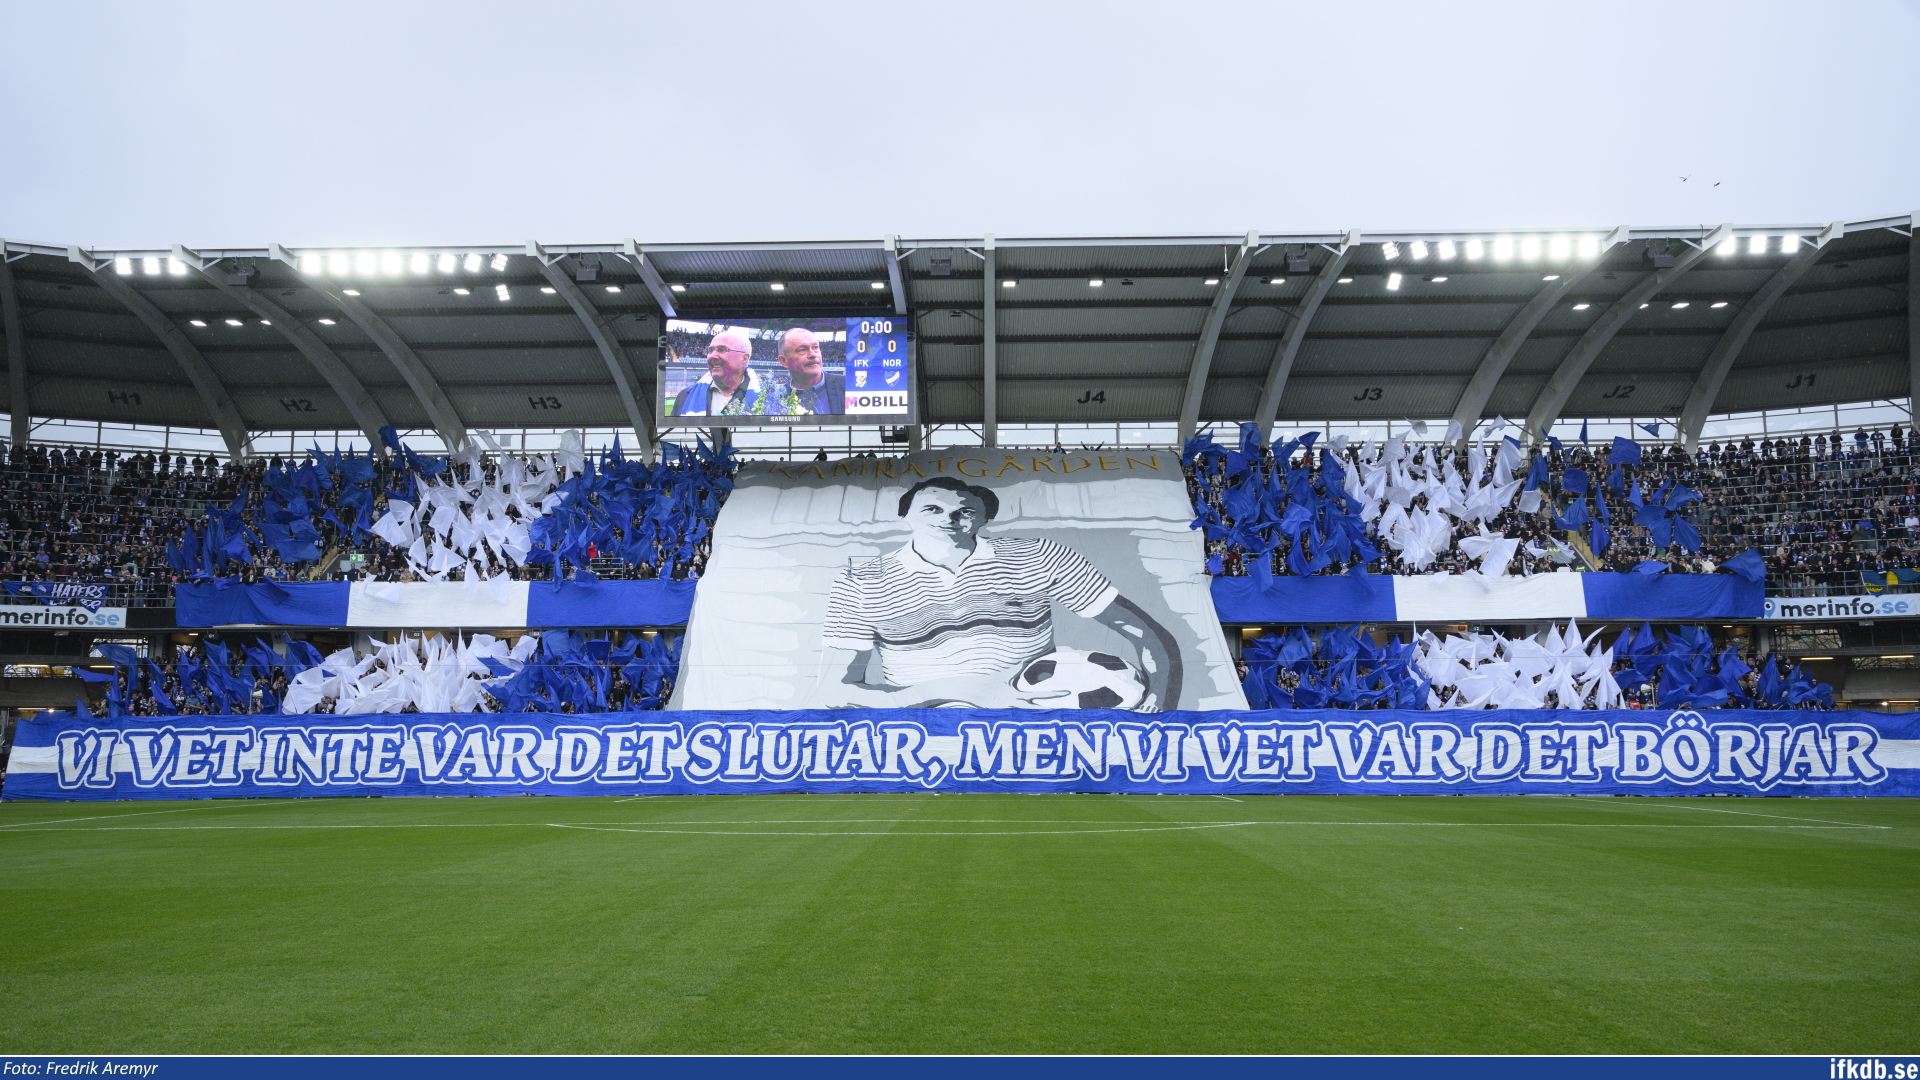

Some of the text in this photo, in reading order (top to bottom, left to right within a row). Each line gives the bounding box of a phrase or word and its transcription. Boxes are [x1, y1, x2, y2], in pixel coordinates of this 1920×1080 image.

[861, 321, 892, 334] 0:00
[857, 340, 897, 353] 0 0
[854, 359, 902, 367] IFK NOR
[1785, 374, 1816, 389] J1
[107, 389, 142, 406] H1
[1077, 390, 1107, 404] J4
[1354, 388, 1383, 401] J3
[1603, 385, 1636, 399] J2
[279, 398, 317, 413] H2
[528, 396, 562, 410] H3
[844, 396, 907, 409] MOBILL
[51, 583, 105, 599] HATERS
[1780, 597, 1909, 617] merinfo.se
[0, 608, 119, 625] merinfo.se
[58, 711, 1886, 790] VI VET INTE VAR DET SLUTAR, MEN VI VET VAR DET BÖRJAR
